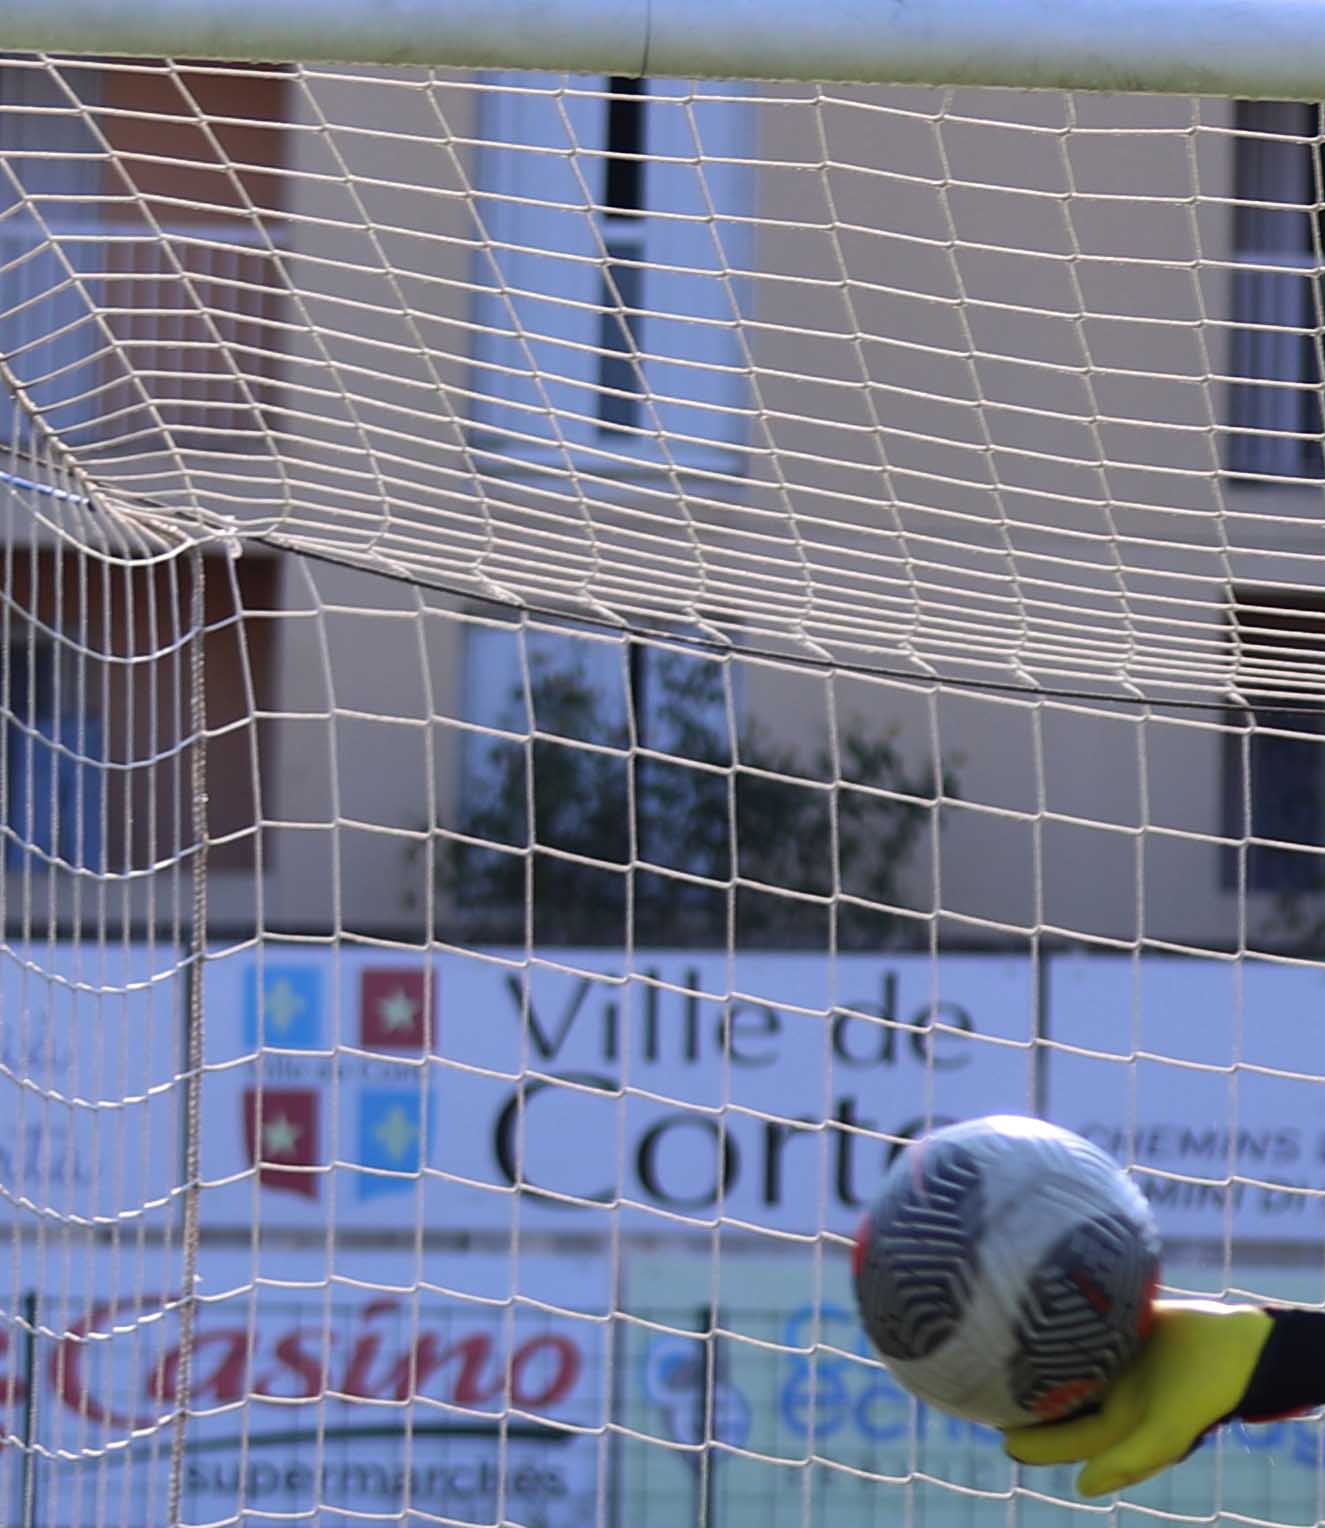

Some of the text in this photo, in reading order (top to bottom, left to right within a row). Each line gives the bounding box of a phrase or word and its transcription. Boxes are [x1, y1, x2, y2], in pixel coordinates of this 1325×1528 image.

[505, 965, 975, 1071] Ville de
[490, 1071, 960, 1212] Cort
[1080, 1123, 1298, 1163] CHEMINS
[48, 1292, 582, 1428] Casino
[188, 1455, 569, 1510] supermarchés
